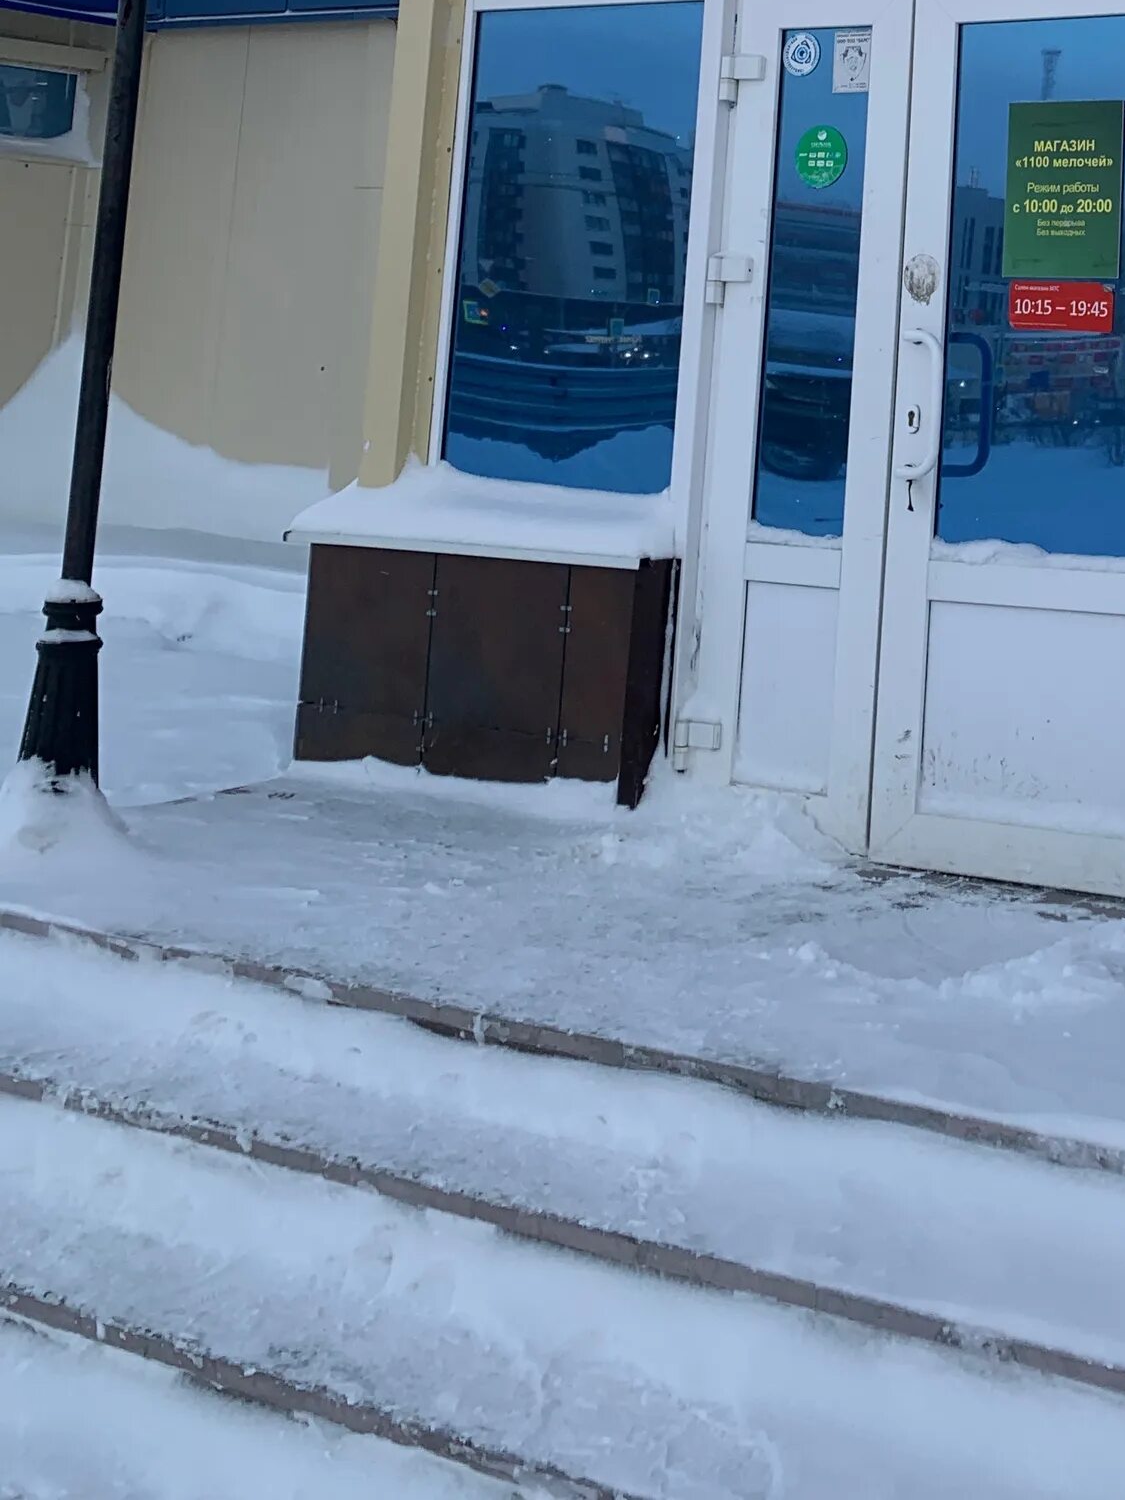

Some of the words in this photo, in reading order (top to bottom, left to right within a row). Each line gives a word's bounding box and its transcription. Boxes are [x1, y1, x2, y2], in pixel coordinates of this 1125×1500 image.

[1034, 139, 1095, 152] МАГАЗИН
[1015, 156, 1050, 168] «1100
[1053, 155, 1113, 168] мелочей»
[1027, 182, 1061, 193] Режим
[1062, 182, 1100, 195] работы
[1012, 203, 1020, 213] с
[1023, 199, 1058, 213] 10:00
[1059, 204, 1074, 214] до
[1076, 199, 1112, 213] 20:00
[1014, 299, 1052, 315] 10:15
[1069, 301, 1108, 317] 19:45
